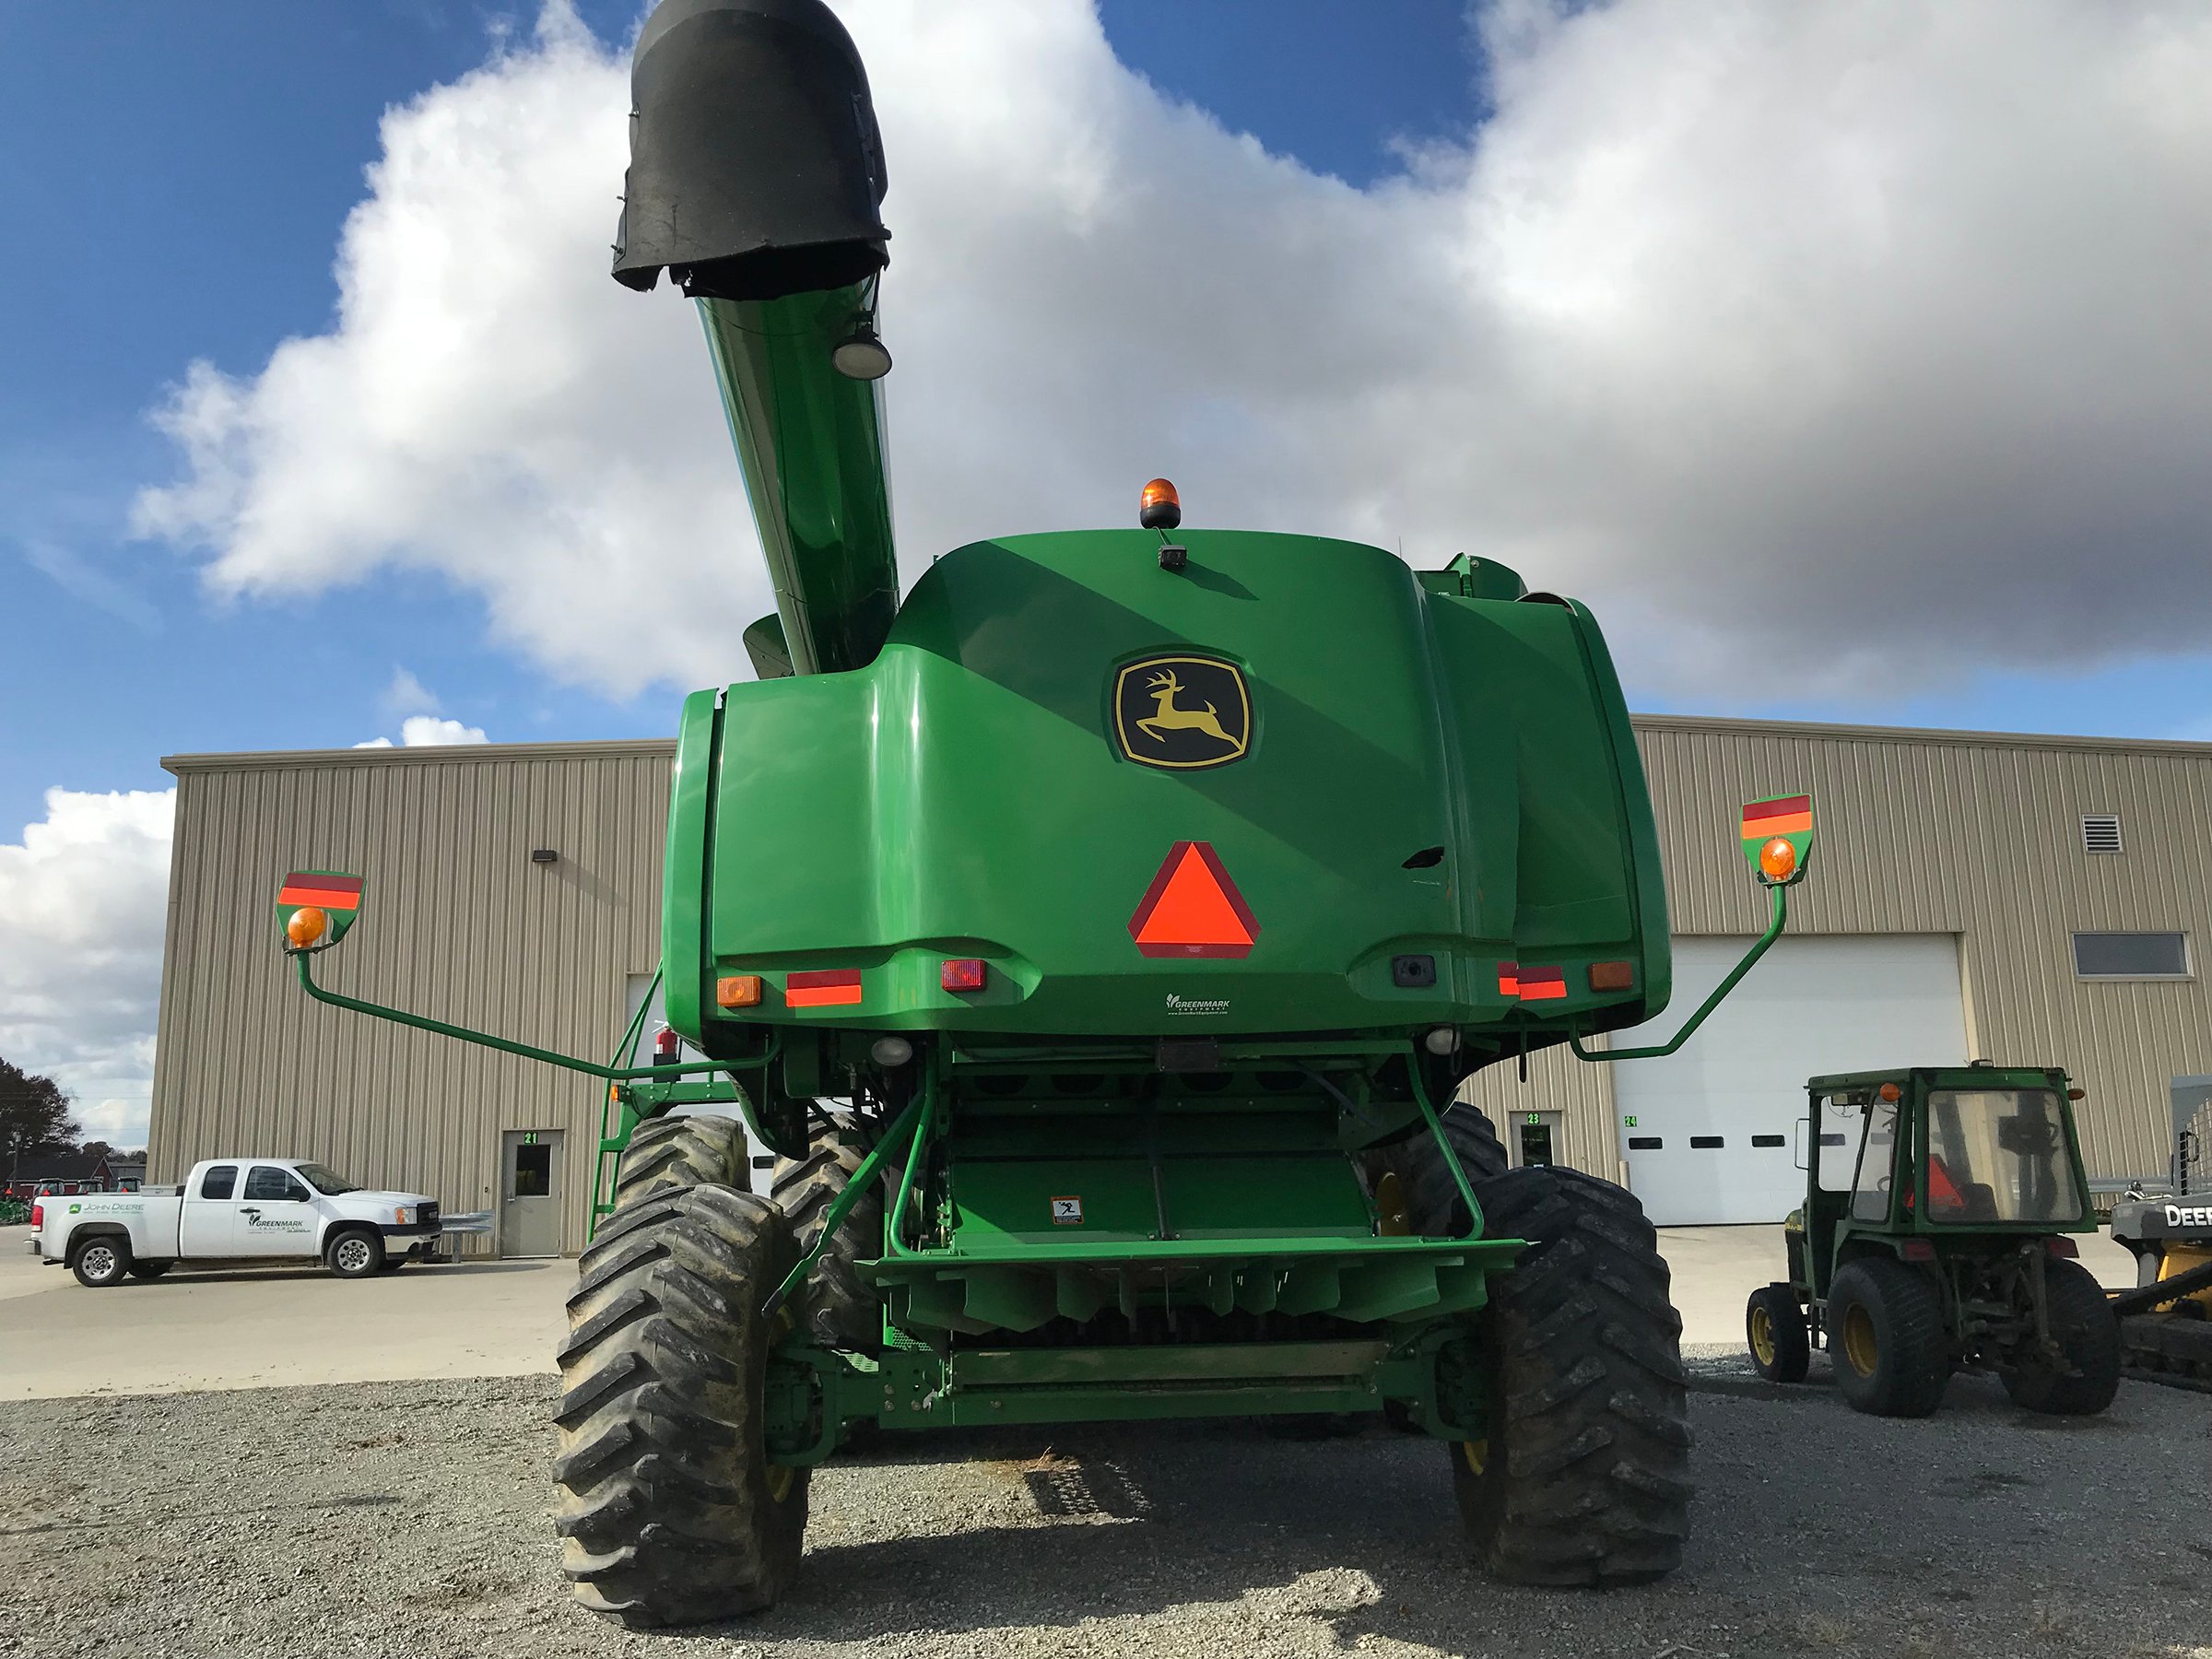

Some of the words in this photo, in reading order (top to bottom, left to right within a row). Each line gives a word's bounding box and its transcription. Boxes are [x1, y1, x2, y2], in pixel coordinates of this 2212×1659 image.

[1174, 1000, 1230, 1008] GREENMARK
[1528, 1113, 1539, 1124] 23
[1625, 1116, 1636, 1126] 24
[524, 1133, 537, 1143] 21
